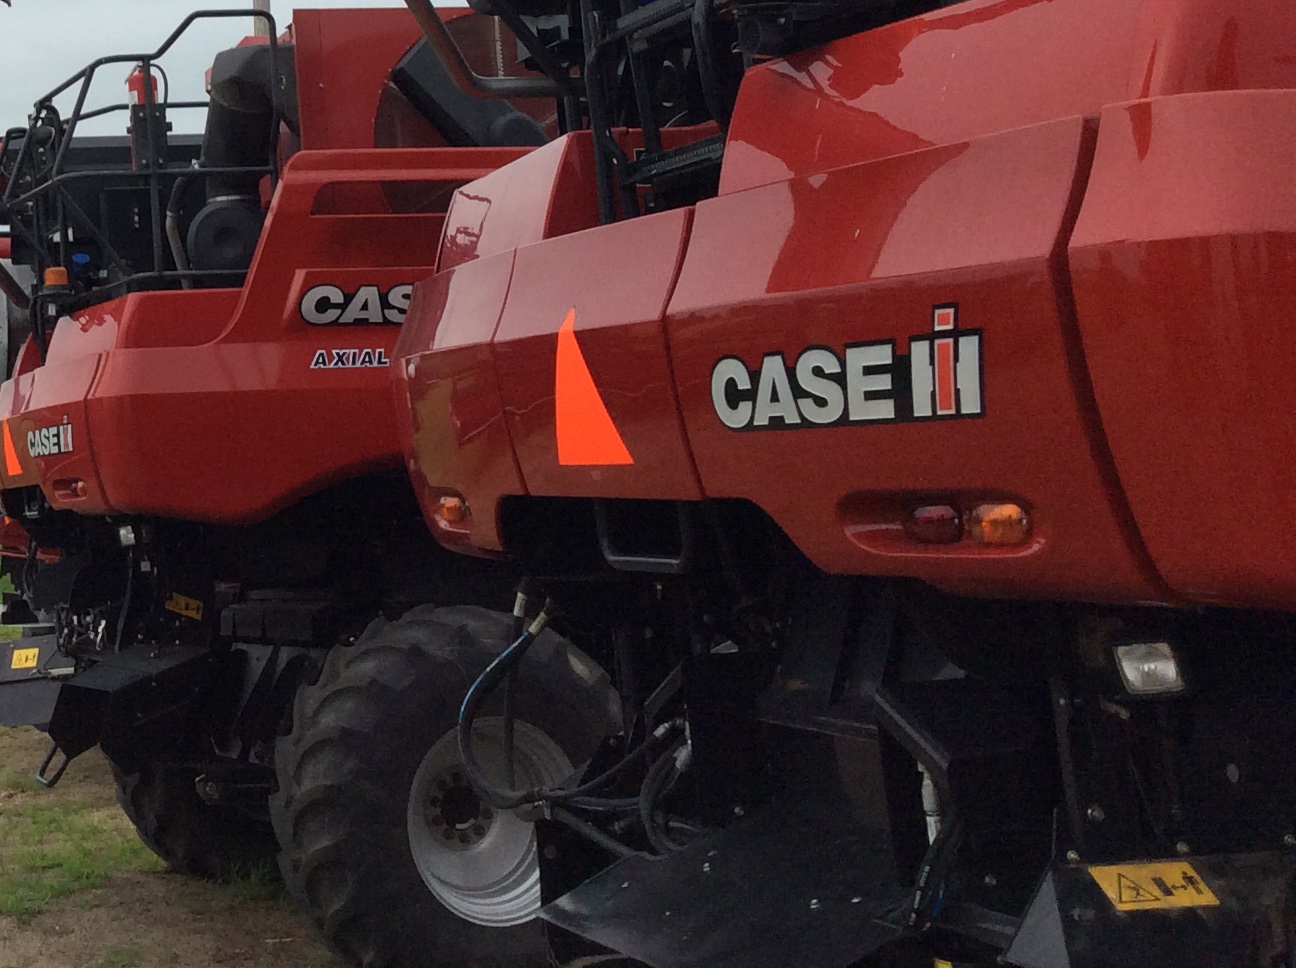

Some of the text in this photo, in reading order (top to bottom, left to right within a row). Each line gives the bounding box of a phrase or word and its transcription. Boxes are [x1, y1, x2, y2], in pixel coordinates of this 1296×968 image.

[310, 348, 390, 369] AXIAL
[711, 343, 896, 429] CASE
[27, 426, 59, 458] CASE
